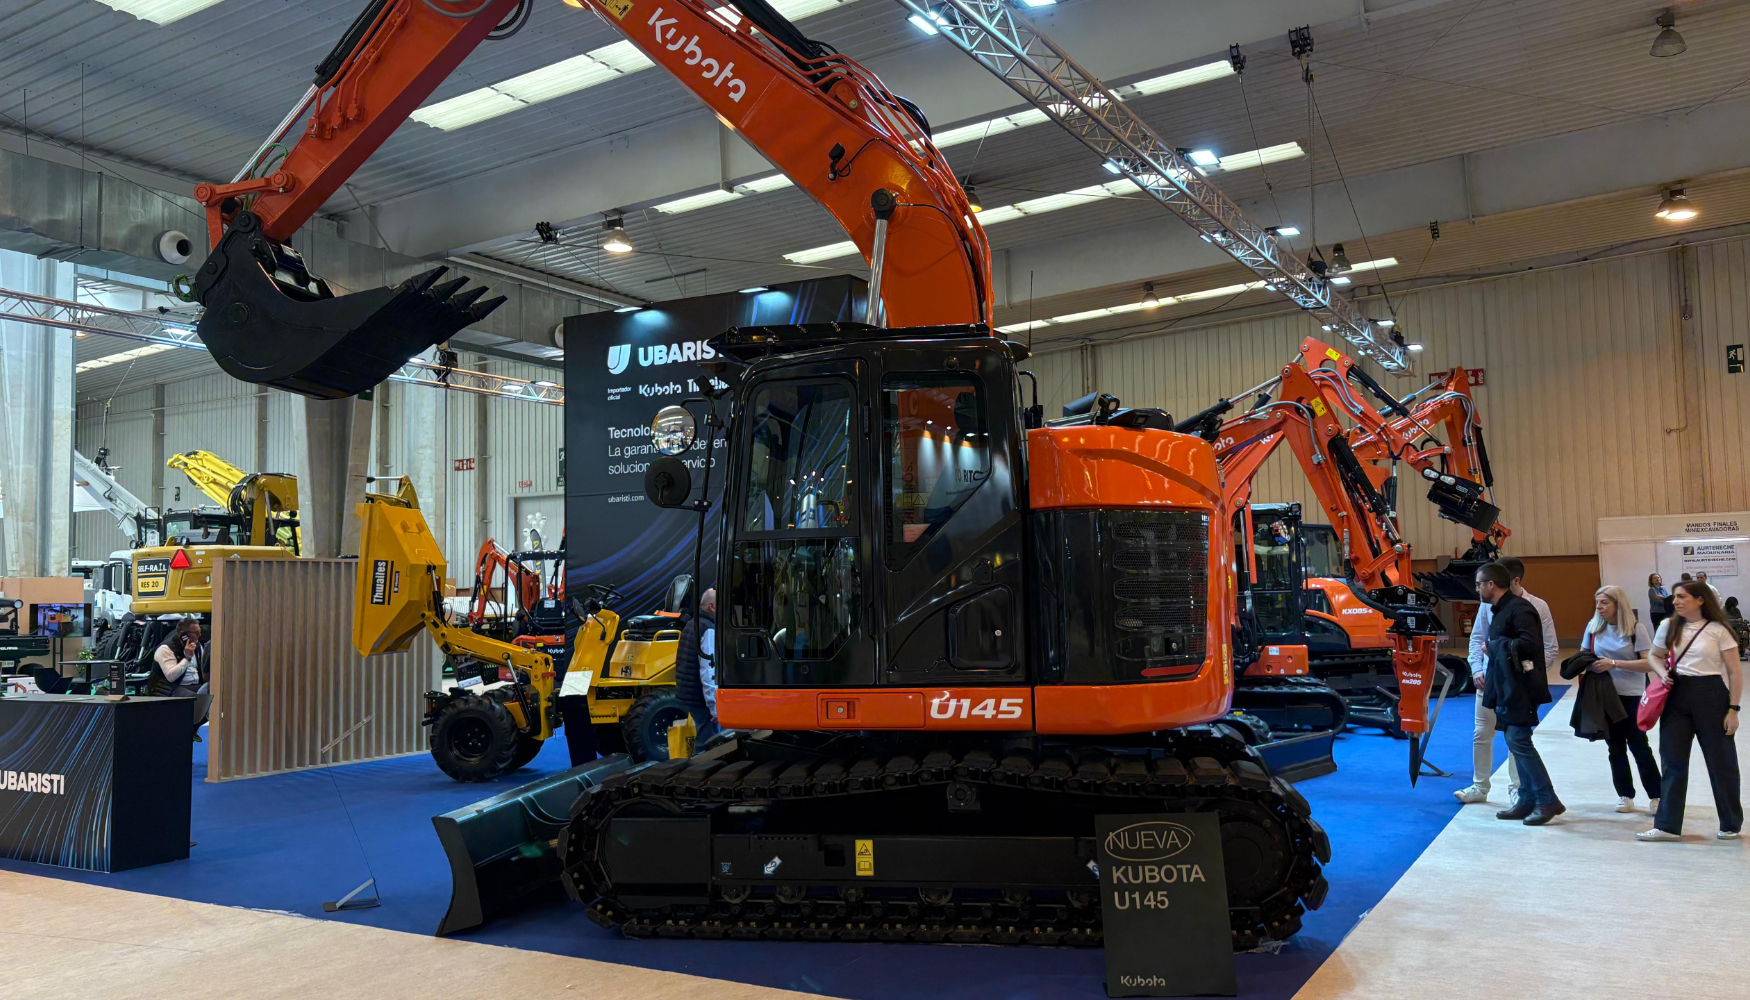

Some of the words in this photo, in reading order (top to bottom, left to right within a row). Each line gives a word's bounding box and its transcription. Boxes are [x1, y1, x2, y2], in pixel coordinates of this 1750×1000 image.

[647, 7, 746, 103] Kubota
[638, 339, 725, 367] UBARIS
[607, 386, 632, 394] Importador
[639, 381, 682, 397] Kubota
[608, 424, 651, 439] Tecnolo
[608, 445, 622, 457] La
[713, 438, 727, 449] en
[608, 494, 645, 503] ubaristi.com
[151, 580, 159, 588] 20
[373, 560, 386, 604] Thwaites
[930, 698, 1024, 719] U145
[0, 770, 65, 795] UBARISTI
[1109, 830, 1183, 850] NUEVA
[1112, 864, 1207, 885] KUBOTA
[1114, 891, 1170, 910] U145
[1120, 974, 1167, 987] Kubota
